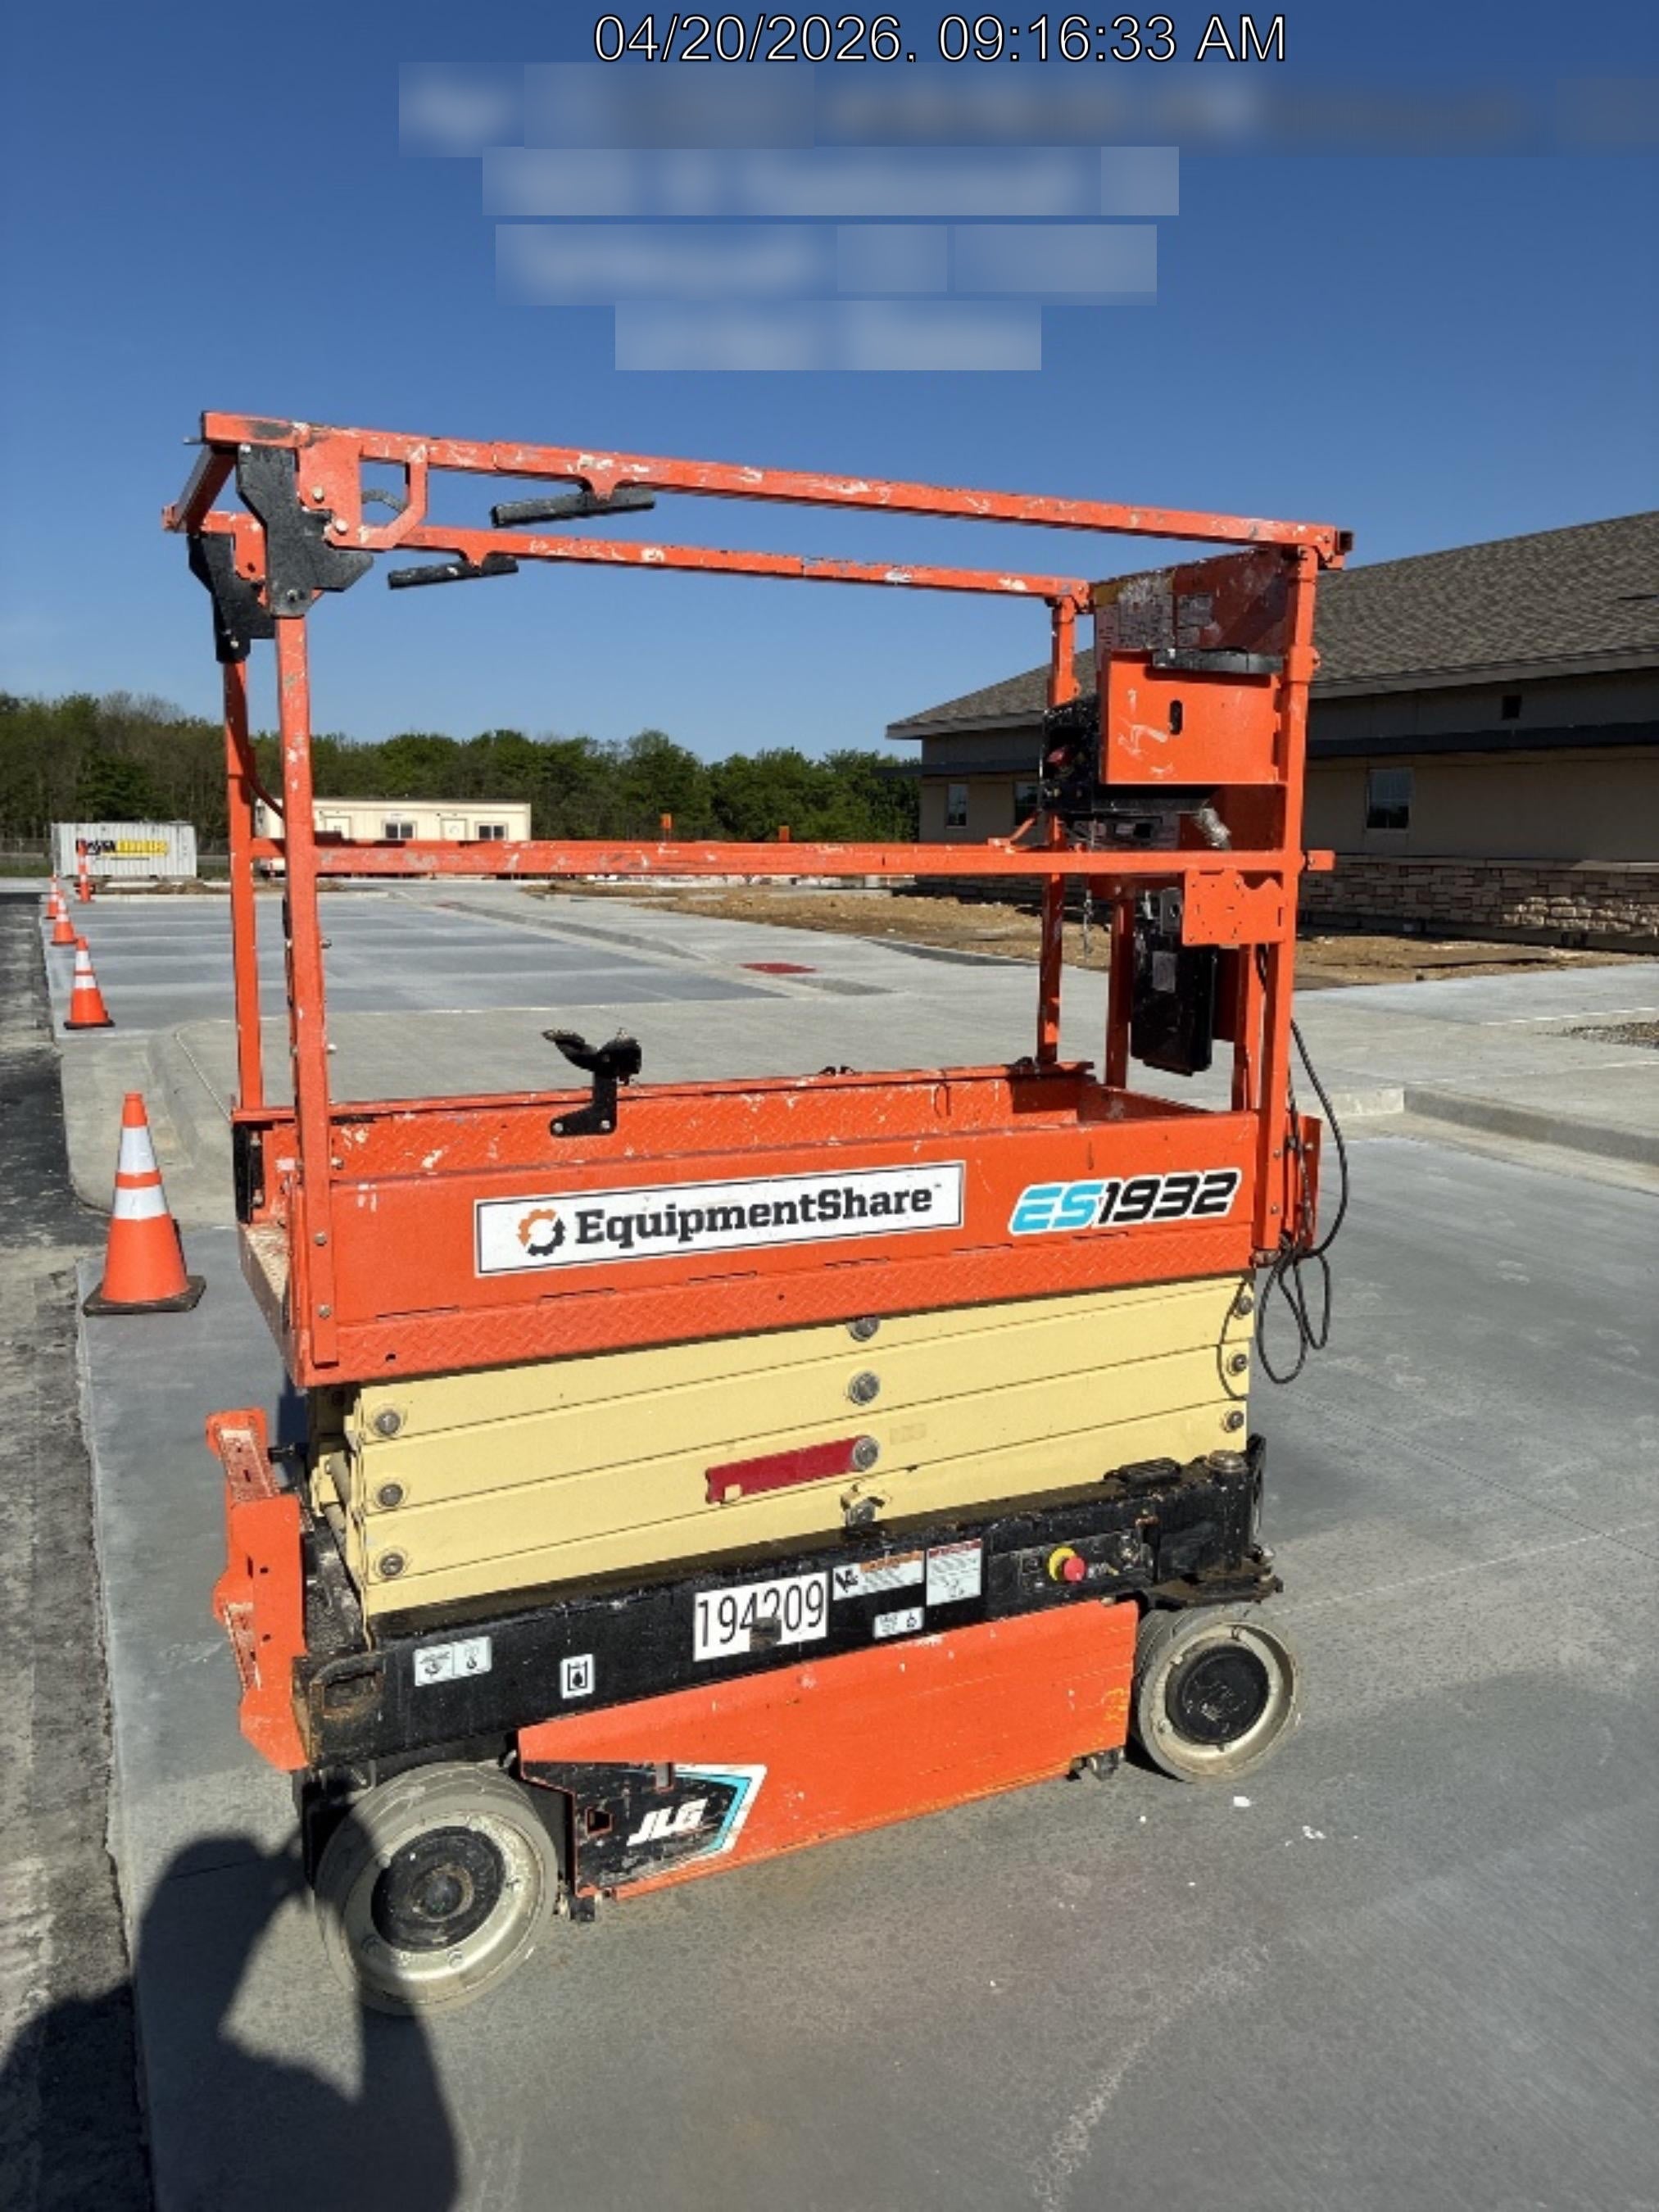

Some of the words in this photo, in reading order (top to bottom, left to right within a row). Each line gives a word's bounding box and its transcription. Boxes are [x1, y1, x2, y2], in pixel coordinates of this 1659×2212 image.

[574, 1187, 932, 1249] EquipmentShare
[1011, 1171, 1240, 1232] ES1932
[697, 1580, 824, 1648] 194209
[626, 1797, 709, 1847] JLG
